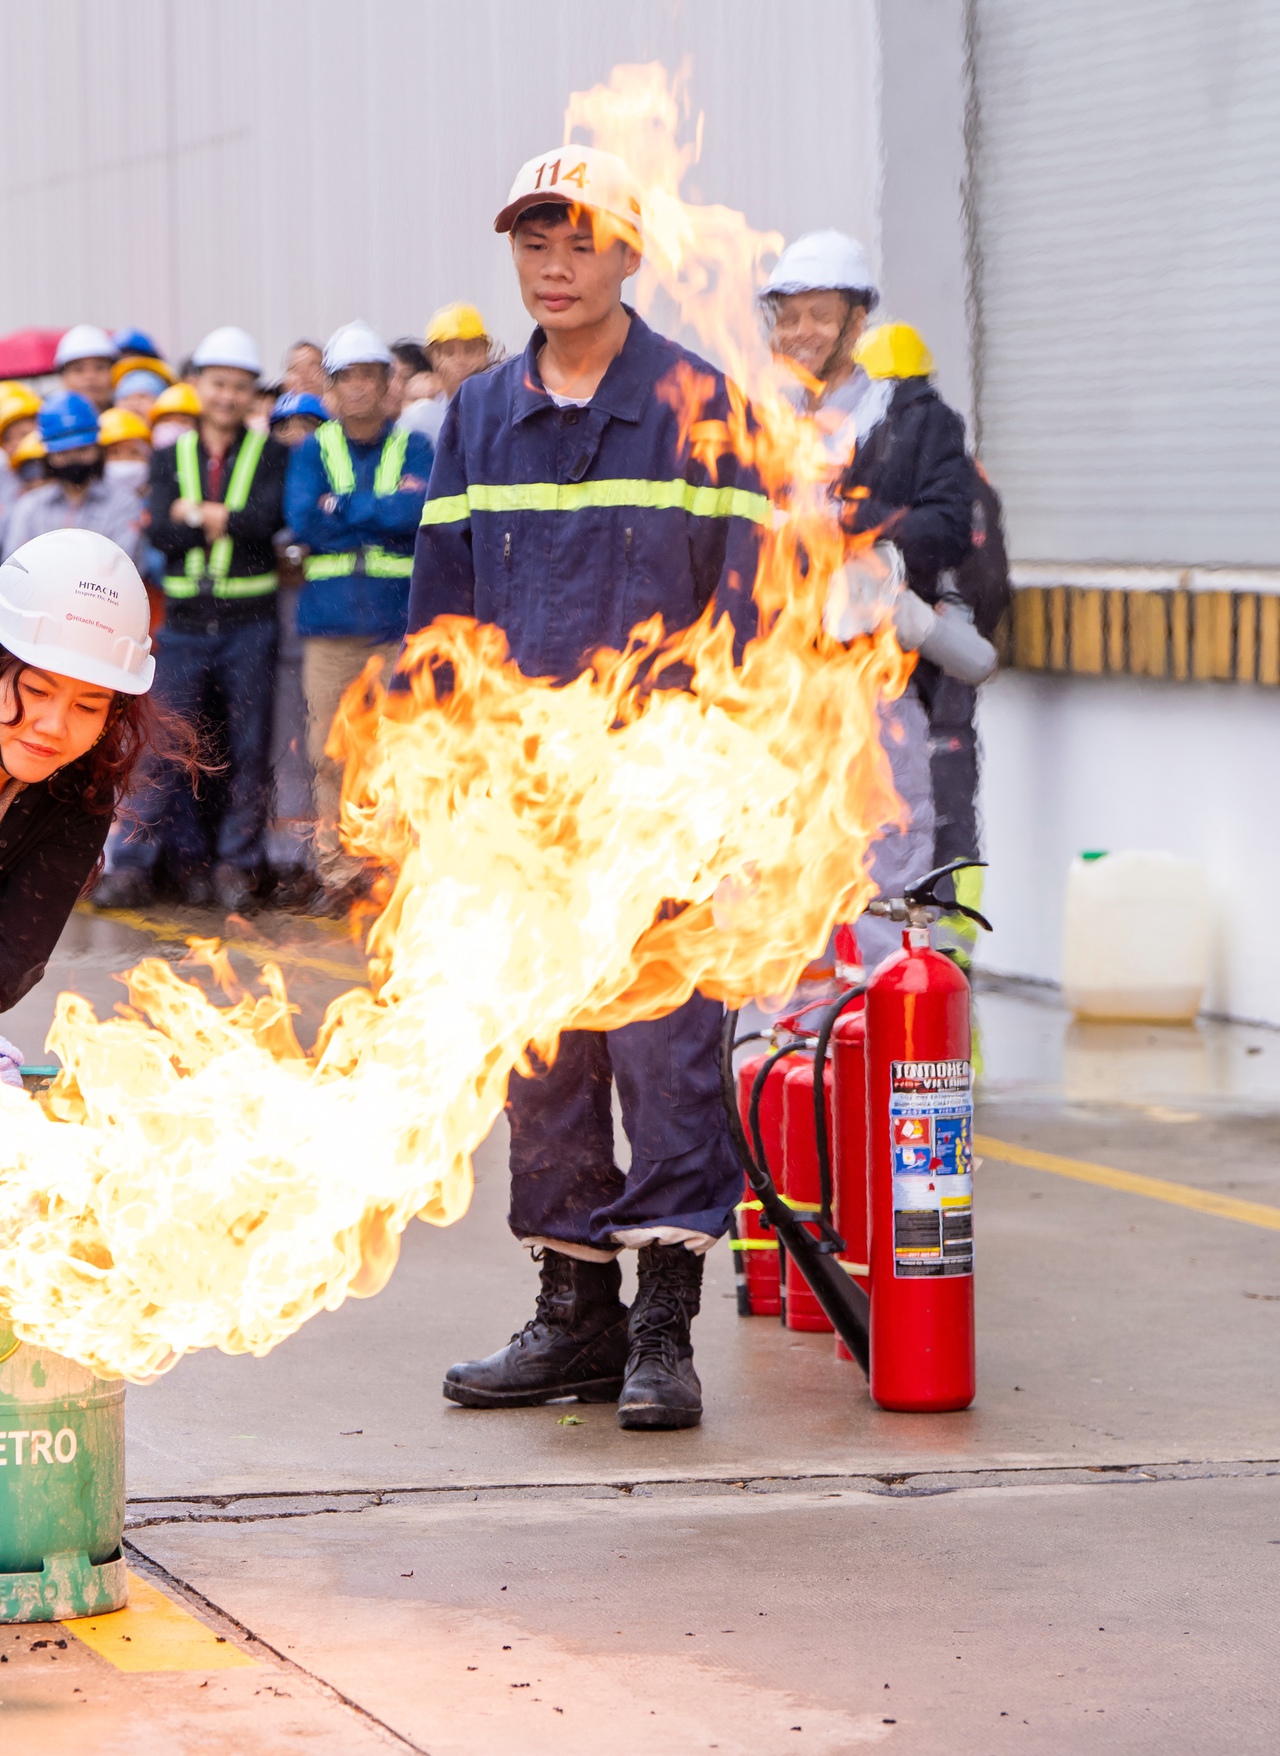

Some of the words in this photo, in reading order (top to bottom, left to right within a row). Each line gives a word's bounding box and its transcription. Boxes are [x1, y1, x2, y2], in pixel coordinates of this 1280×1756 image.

[534, 159, 590, 190] 114
[79, 581, 119, 598] HITACHI
[73, 615, 95, 625] Hitachi
[95, 621, 114, 634] Energy
